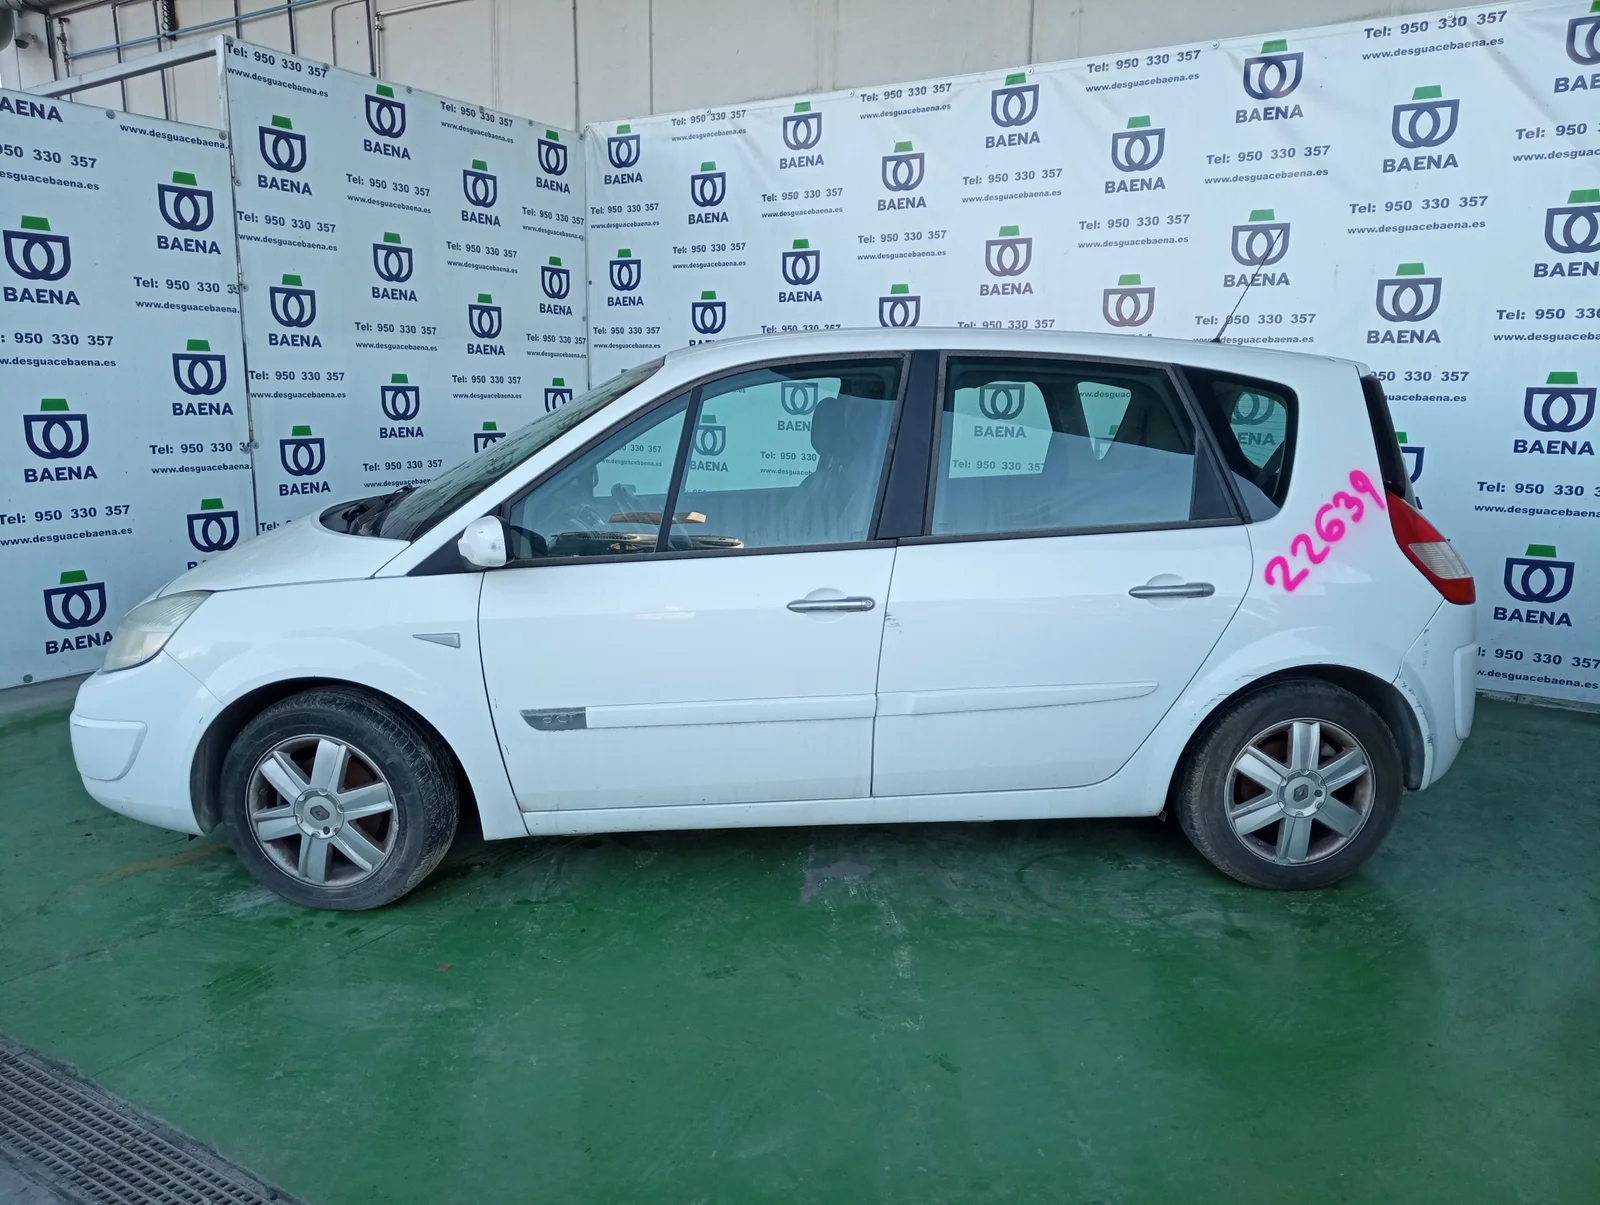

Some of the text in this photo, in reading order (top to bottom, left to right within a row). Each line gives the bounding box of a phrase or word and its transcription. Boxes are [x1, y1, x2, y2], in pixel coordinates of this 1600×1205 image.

[1364, 10, 1507, 39] Tel: 950 330 357
[1362, 38, 1504, 60] www.desguacebaena.es
[225, 44, 327, 79] Tel: 950 330 357
[1087, 49, 1201, 73] Tel: 950 330 357
[226, 68, 329, 98] www.desguacebaena.es
[1086, 73, 1199, 92] www.desguacebaena.es
[860, 83, 952, 102] Tel: 950 330 357
[0, 96, 63, 123] AENA
[440, 101, 513, 127] Tel: 950 330 357
[860, 104, 951, 119] www.desguacebaena.es
[1235, 104, 1304, 124] BAENA
[671, 109, 747, 126] Tel: 950 330 357
[441, 122, 514, 144] www.desguacebaena.es
[672, 129, 746, 141] www.desguacebaena.es
[1515, 127, 1545, 140] Tel:
[1556, 123, 1587, 136] 950
[985, 131, 1040, 149] BAENA
[363, 139, 411, 160] BAENA
[1206, 145, 1331, 164] Tel: 950 330 357
[33, 149, 97, 168] 330 357
[780, 154, 824, 169] BAENA
[1383, 153, 1459, 173] BAENA
[0, 171, 99, 190] esguacebaena.es
[604, 172, 643, 185] BAENA
[962, 168, 1063, 185] Tel: 950 330 357
[1204, 169, 1328, 184] www.desguacebaena.es
[257, 174, 312, 196] BAENA
[346, 173, 430, 197] Tel: 950 330 357
[536, 176, 570, 194] BAENA
[1105, 177, 1166, 194] BAENA
[761, 188, 843, 202] Tel: 950 330 357
[962, 190, 1062, 203] www.desguacebaena.es
[347, 195, 431, 214] www.desguacebaena.es
[607, 205, 623, 214] 950
[627, 204, 641, 213] 330
[645, 203, 659, 212] 357
[878, 196, 927, 211] BAENA
[461, 210, 501, 227] BAENA
[522, 206, 584, 225] Tel: 950 330 357
[688, 211, 729, 225] BAENA
[761, 208, 843, 218] www.desguacebaena.es
[591, 221, 660, 229] www.desguacebaena.es
[157, 235, 221, 255] BAENA
[1533, 261, 1600, 278] BAEN
[133, 276, 158, 288] Tel:
[166, 279, 190, 291] 950
[197, 282, 220, 293] 330
[1223, 273, 1290, 288] BAENA
[3, 286, 80, 306] BAENA
[372, 286, 418, 302] BAENA
[779, 290, 823, 303] BAENA
[980, 282, 1033, 296] BAENA
[135, 301, 240, 313] www.desguacebaena.
[607, 296, 644, 307] BAENA
[539, 303, 573, 316] BAENA
[1496, 308, 1565, 320] Tel: 950
[1195, 313, 1316, 326] Tel: 950 330 357
[14, 332, 43, 344] 950
[52, 334, 79, 345] 330
[87, 335, 113, 346] 357
[268, 333, 322, 348] BAENA
[1367, 329, 1441, 344] BAENA
[467, 343, 506, 356] BAENA
[0, 357, 116, 367] w.desguacebaena.es
[248, 371, 345, 381] Tel: 950 330 357
[1404, 371, 1469, 382] 330 357
[250, 391, 347, 401] www.desguacebaena.es
[172, 402, 234, 416] BAENA
[379, 426, 424, 439] BAENA
[778, 420, 810, 431] BAEN
[975, 426, 1026, 438] BAENA
[1238, 432, 1275, 445] ENA
[149, 444, 174, 455] Tel:
[180, 443, 204, 454] 950
[210, 442, 233, 452] 330
[631, 444, 644, 452] 330
[1513, 439, 1595, 456] BAENA
[760, 451, 817, 461] Tel: 950 330
[151, 463, 252, 474] www.desguacebaena.
[362, 459, 443, 472] Tel: 950 330 357
[690, 460, 729, 473] BAENA
[952, 460, 1021, 470] Tel: 950 330
[24, 465, 98, 483] BAENA
[279, 481, 331, 496] BAENA
[1477, 481, 1505, 492] Tel:
[1515, 483, 1544, 494] 950
[1554, 485, 1584, 496] 330
[0, 504, 130, 525] Tel: 950 330 357
[0, 528, 133, 546] www.desguacebaena.es
[1264, 469, 1386, 592] 22639
[1493, 606, 1572, 627] BAENA
[45, 631, 113, 655] BAENA
[1495, 649, 1523, 661] 950
[1532, 653, 1562, 665] 330
[1571, 657, 1600, 669] 357
